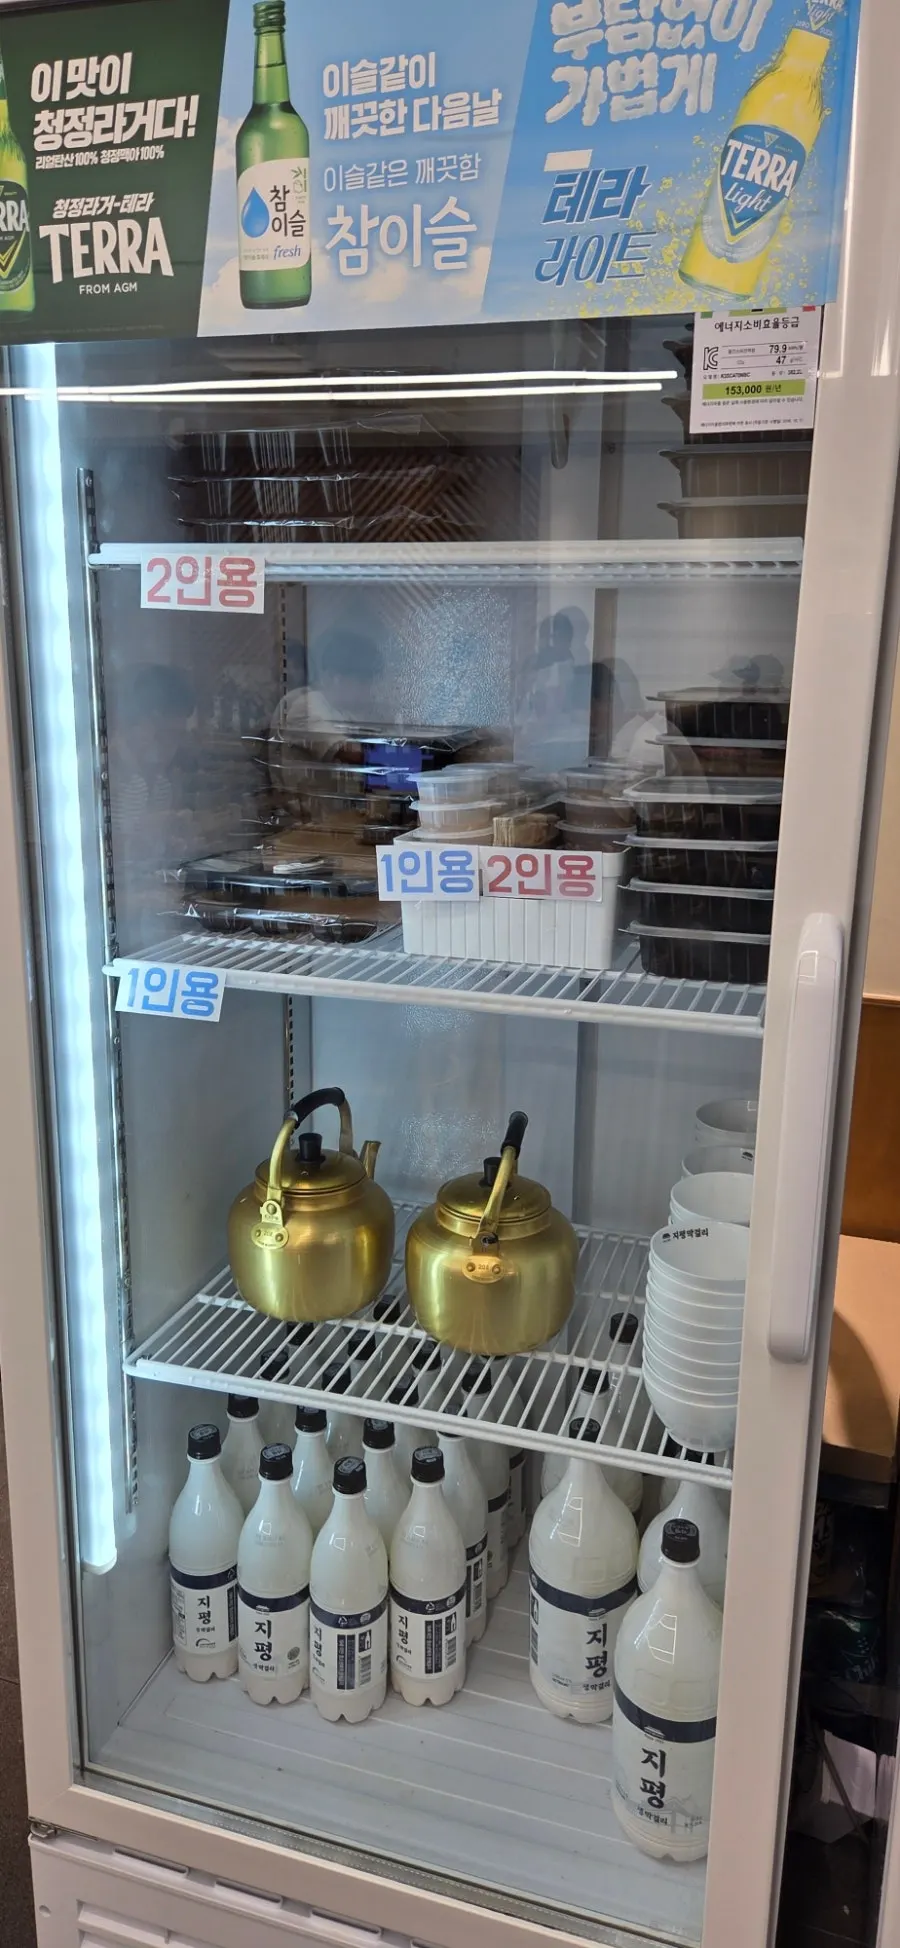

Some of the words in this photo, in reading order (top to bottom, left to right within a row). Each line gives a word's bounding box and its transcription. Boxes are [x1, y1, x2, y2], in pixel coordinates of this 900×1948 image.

[323, 52, 436, 98] 이슬같이
[545, 52, 717, 126] 가볍게
[33, 94, 200, 152] 청정라거다!
[323, 97, 408, 140] 깨끗한
[413, 88, 502, 133] 다음날
[323, 159, 409, 193] 이슬같은
[416, 152, 482, 185] 깨끗함
[721, 138, 798, 197] TERRA
[0, 199, 30, 233] RRA
[52, 191, 155, 219] 청정라거-테라
[541, 164, 652, 225] 테라
[724, 182, 772, 214] Light
[39, 216, 175, 285] TERRA
[273, 243, 302, 261] fresh
[325, 196, 478, 276] 참이슬
[534, 231, 657, 287] 라이트
[79, 283, 111, 295] FROM
[114, 281, 138, 293] AGM
[714, 316, 800, 333] 에너지소비효율등급
[769, 344, 787, 354] 79.9
[776, 356, 787, 365] 47
[725, 384, 762, 396] 153,000
[146, 555, 258, 608] 2인용
[380, 850, 475, 894] 1인용
[487, 853, 596, 897] 2인용
[127, 967, 219, 1017] 1인용
[672, 1228, 709, 1240] 지평막걸리
[197, 1595, 212, 1625] 지평
[254, 1620, 272, 1661] 지평
[585, 1622, 608, 1678] 지평
[640, 1747, 667, 1809] 지평
